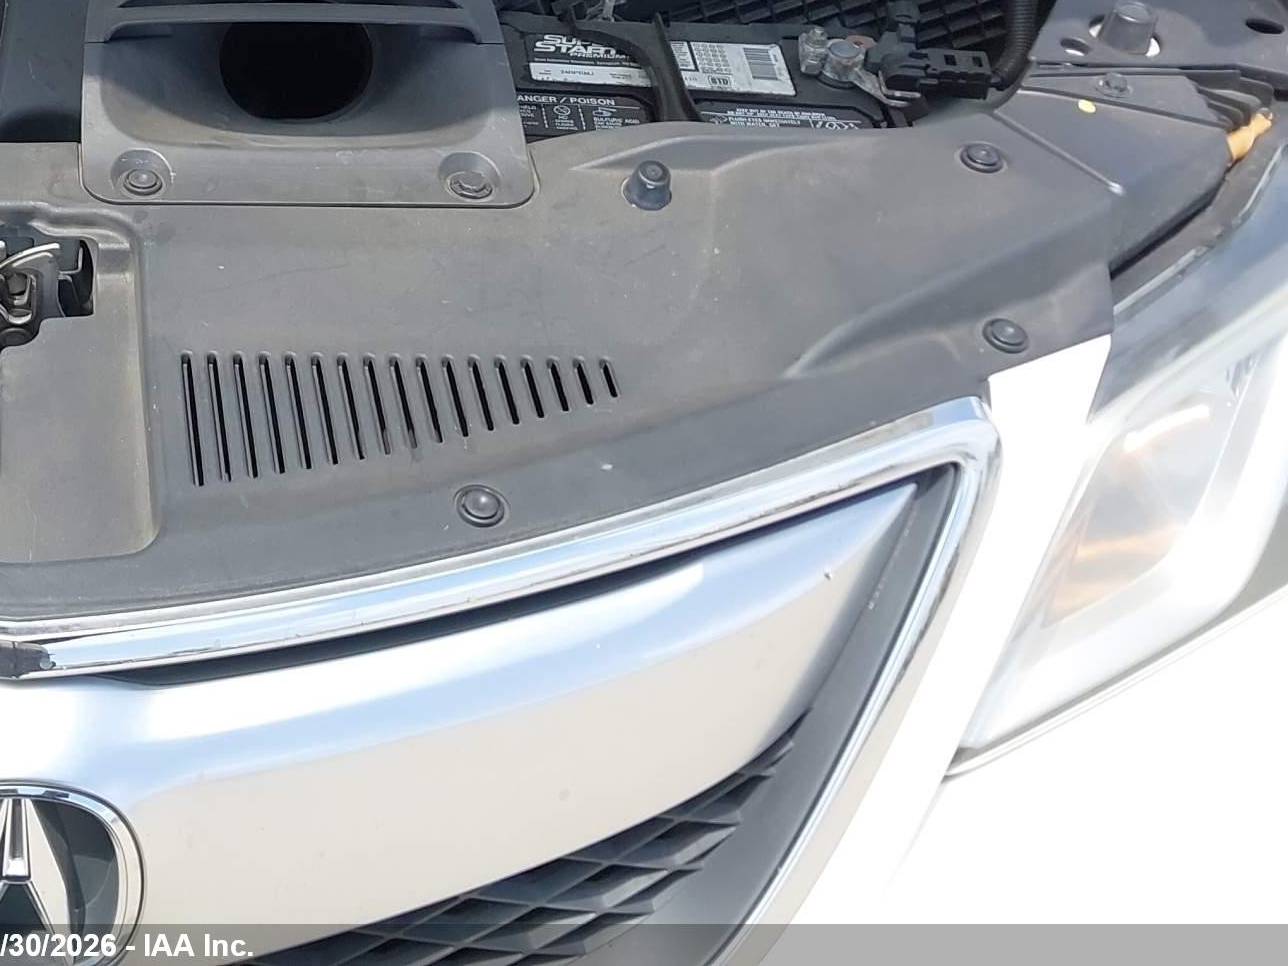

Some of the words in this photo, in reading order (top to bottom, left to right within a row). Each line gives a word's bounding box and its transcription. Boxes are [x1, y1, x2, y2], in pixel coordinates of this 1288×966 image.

[533, 40, 617, 55] STAR
[516, 94, 558, 104] ANGER
[569, 96, 617, 106] POISON
